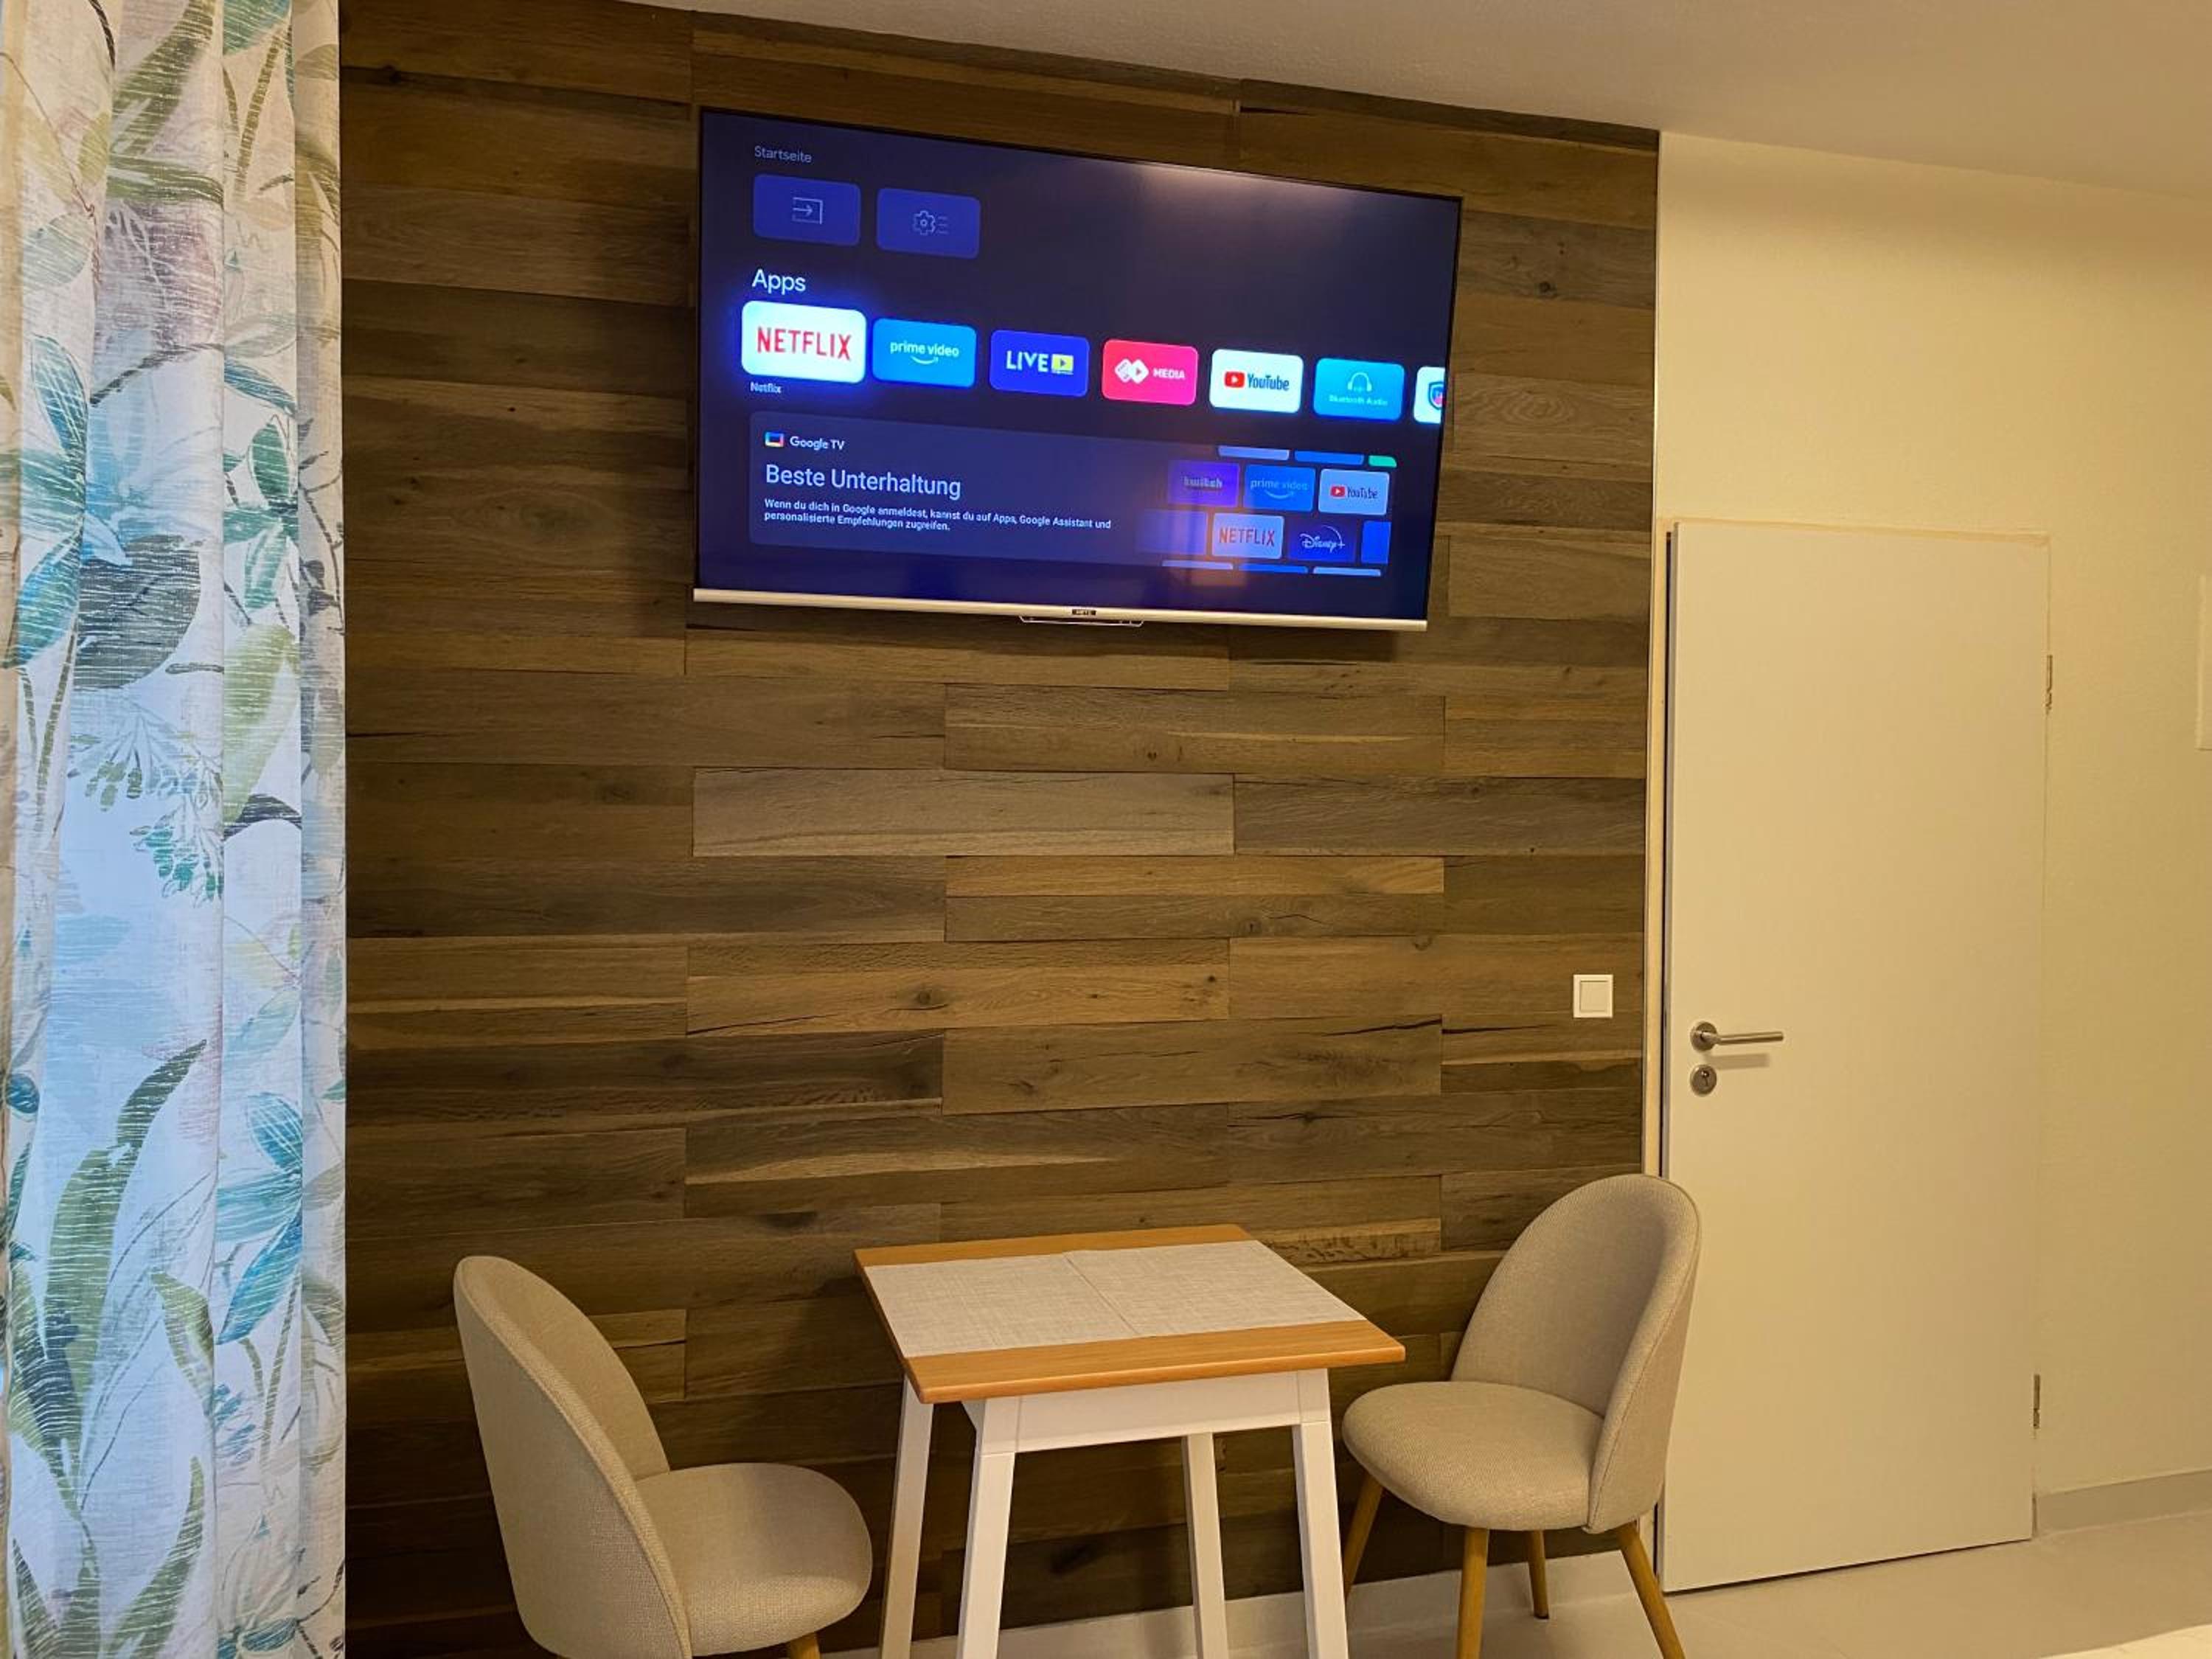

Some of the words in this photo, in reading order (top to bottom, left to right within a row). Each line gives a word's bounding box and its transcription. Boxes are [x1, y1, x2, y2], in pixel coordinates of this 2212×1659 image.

[754, 145, 813, 164] Startseite
[751, 269, 806, 295] Apps
[757, 327, 852, 361] NETFLIX
[890, 341, 925, 355] prime
[927, 343, 959, 358] video
[1006, 350, 1048, 372] LIVE
[1153, 368, 1186, 379] MEDIA
[1247, 373, 1290, 392] YouTube
[750, 381, 782, 394] Netflix
[790, 435, 828, 451] Google
[830, 439, 845, 450] TV
[765, 464, 825, 487] Beste
[831, 468, 961, 501] Unterhaltung
[1183, 476, 1223, 489] twitch
[1250, 479, 1280, 490] prime
[1281, 481, 1310, 492] video
[1346, 488, 1378, 499] YouTube
[764, 498, 792, 509] Wenn
[793, 500, 807, 510] du
[809, 501, 830, 512] dich
[832, 502, 840, 512] in
[843, 504, 875, 515] Google
[877, 505, 928, 519] anmeldest,
[930, 508, 961, 520] kannst
[962, 511, 974, 521] du
[976, 512, 991, 522] auf
[993, 514, 1017, 525] Apps,
[1020, 515, 1051, 526] Google
[1052, 517, 1093, 528] Assistant
[1095, 520, 1111, 529] und
[764, 512, 835, 524] personalisierte
[837, 515, 904, 529] Empfehlungen
[905, 520, 950, 532] zugreifen.
[1220, 527, 1275, 547] NETFLIX
[1300, 532, 1345, 554] Disney+
